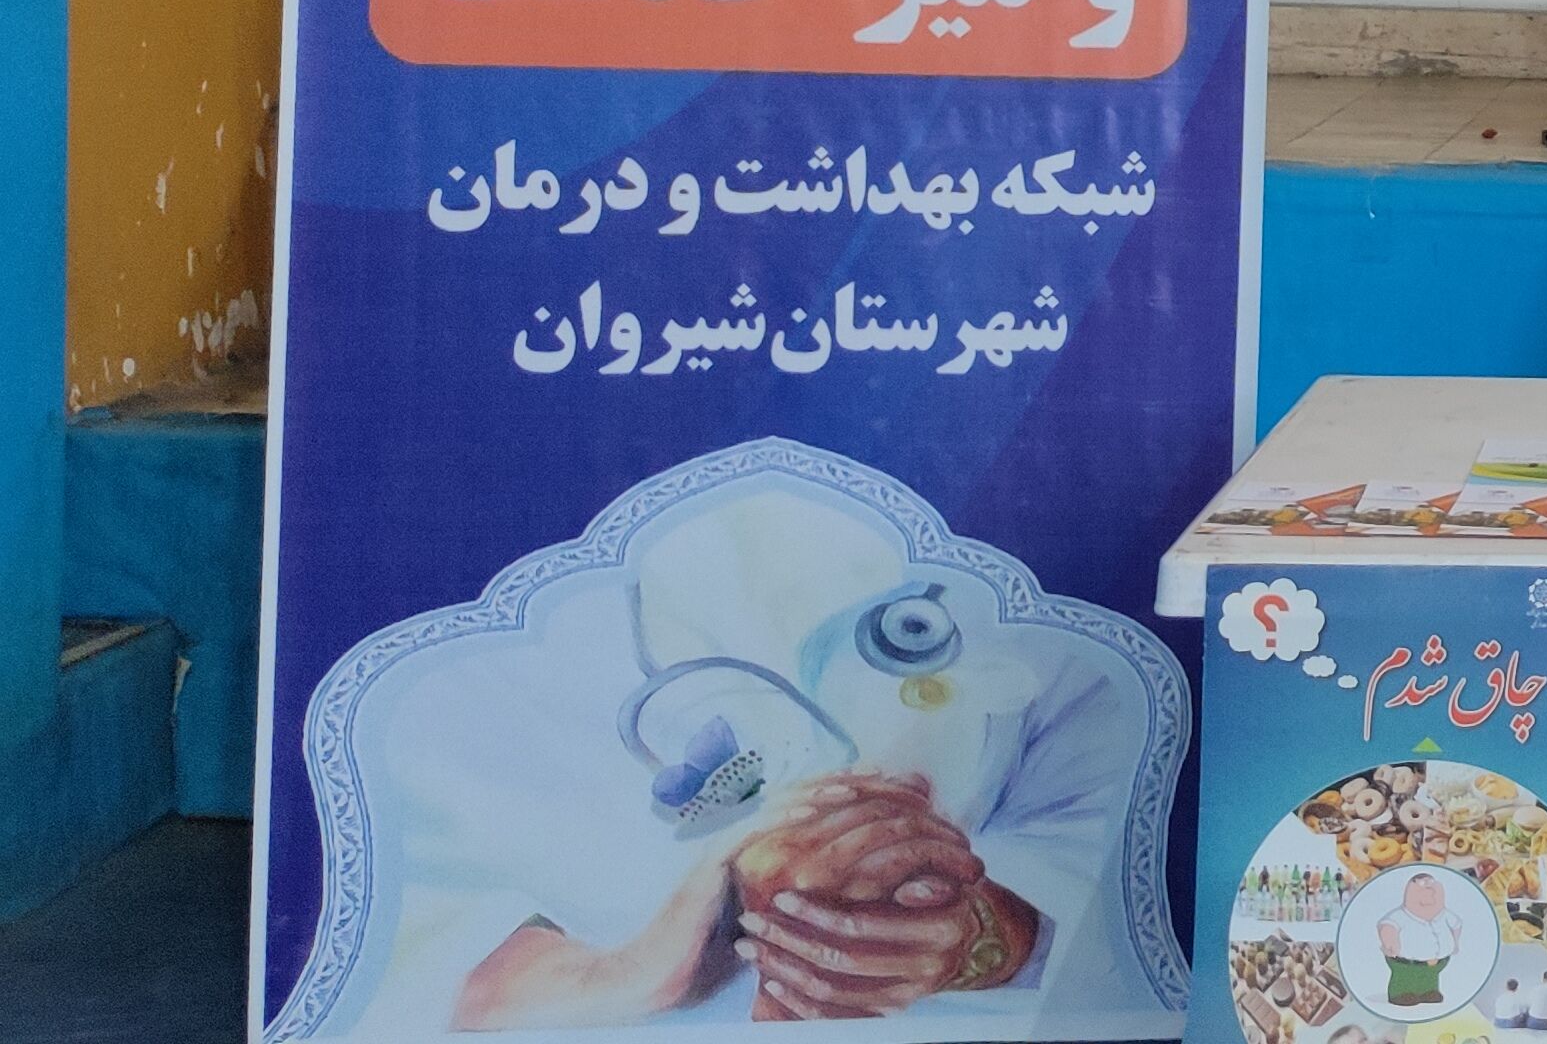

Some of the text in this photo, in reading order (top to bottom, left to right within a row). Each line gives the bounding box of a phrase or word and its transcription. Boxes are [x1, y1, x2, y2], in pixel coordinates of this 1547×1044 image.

[427, 139, 1157, 237] شبکه بهداشت و درمان
[512, 279, 1070, 376] شهرستان شیروان
[1363, 634, 1449, 742] شدم
[1448, 639, 1547, 744] چاق
